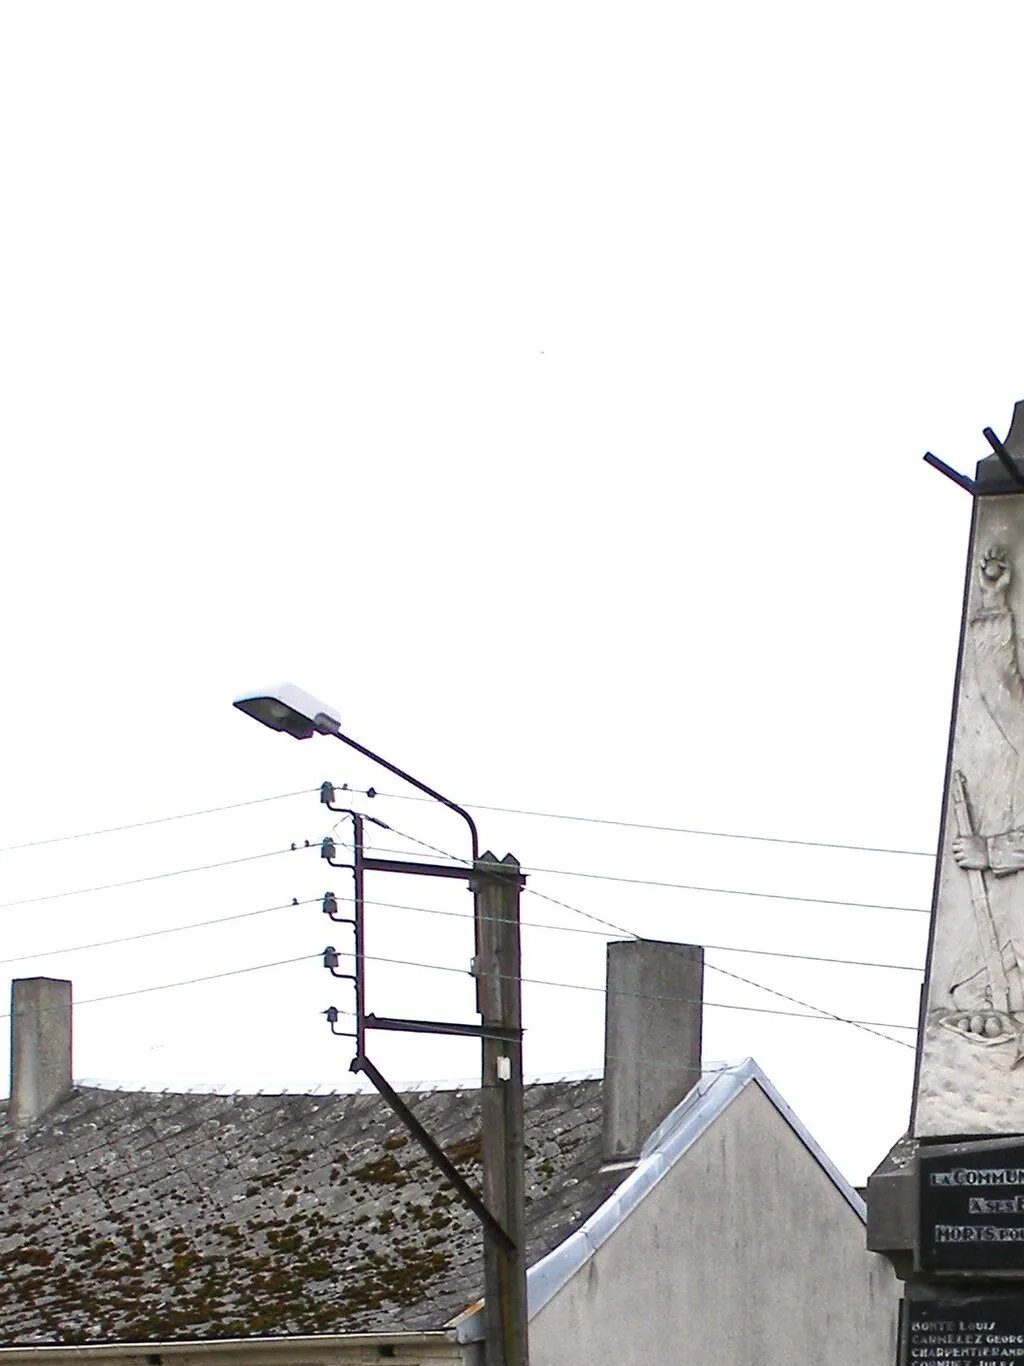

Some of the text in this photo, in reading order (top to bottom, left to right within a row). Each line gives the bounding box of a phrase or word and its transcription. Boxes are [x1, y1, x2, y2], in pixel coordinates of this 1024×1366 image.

[930, 1173, 950, 1185] LA
[984, 1200, 1015, 1213] SES
[935, 1225, 995, 1242] MORTS
